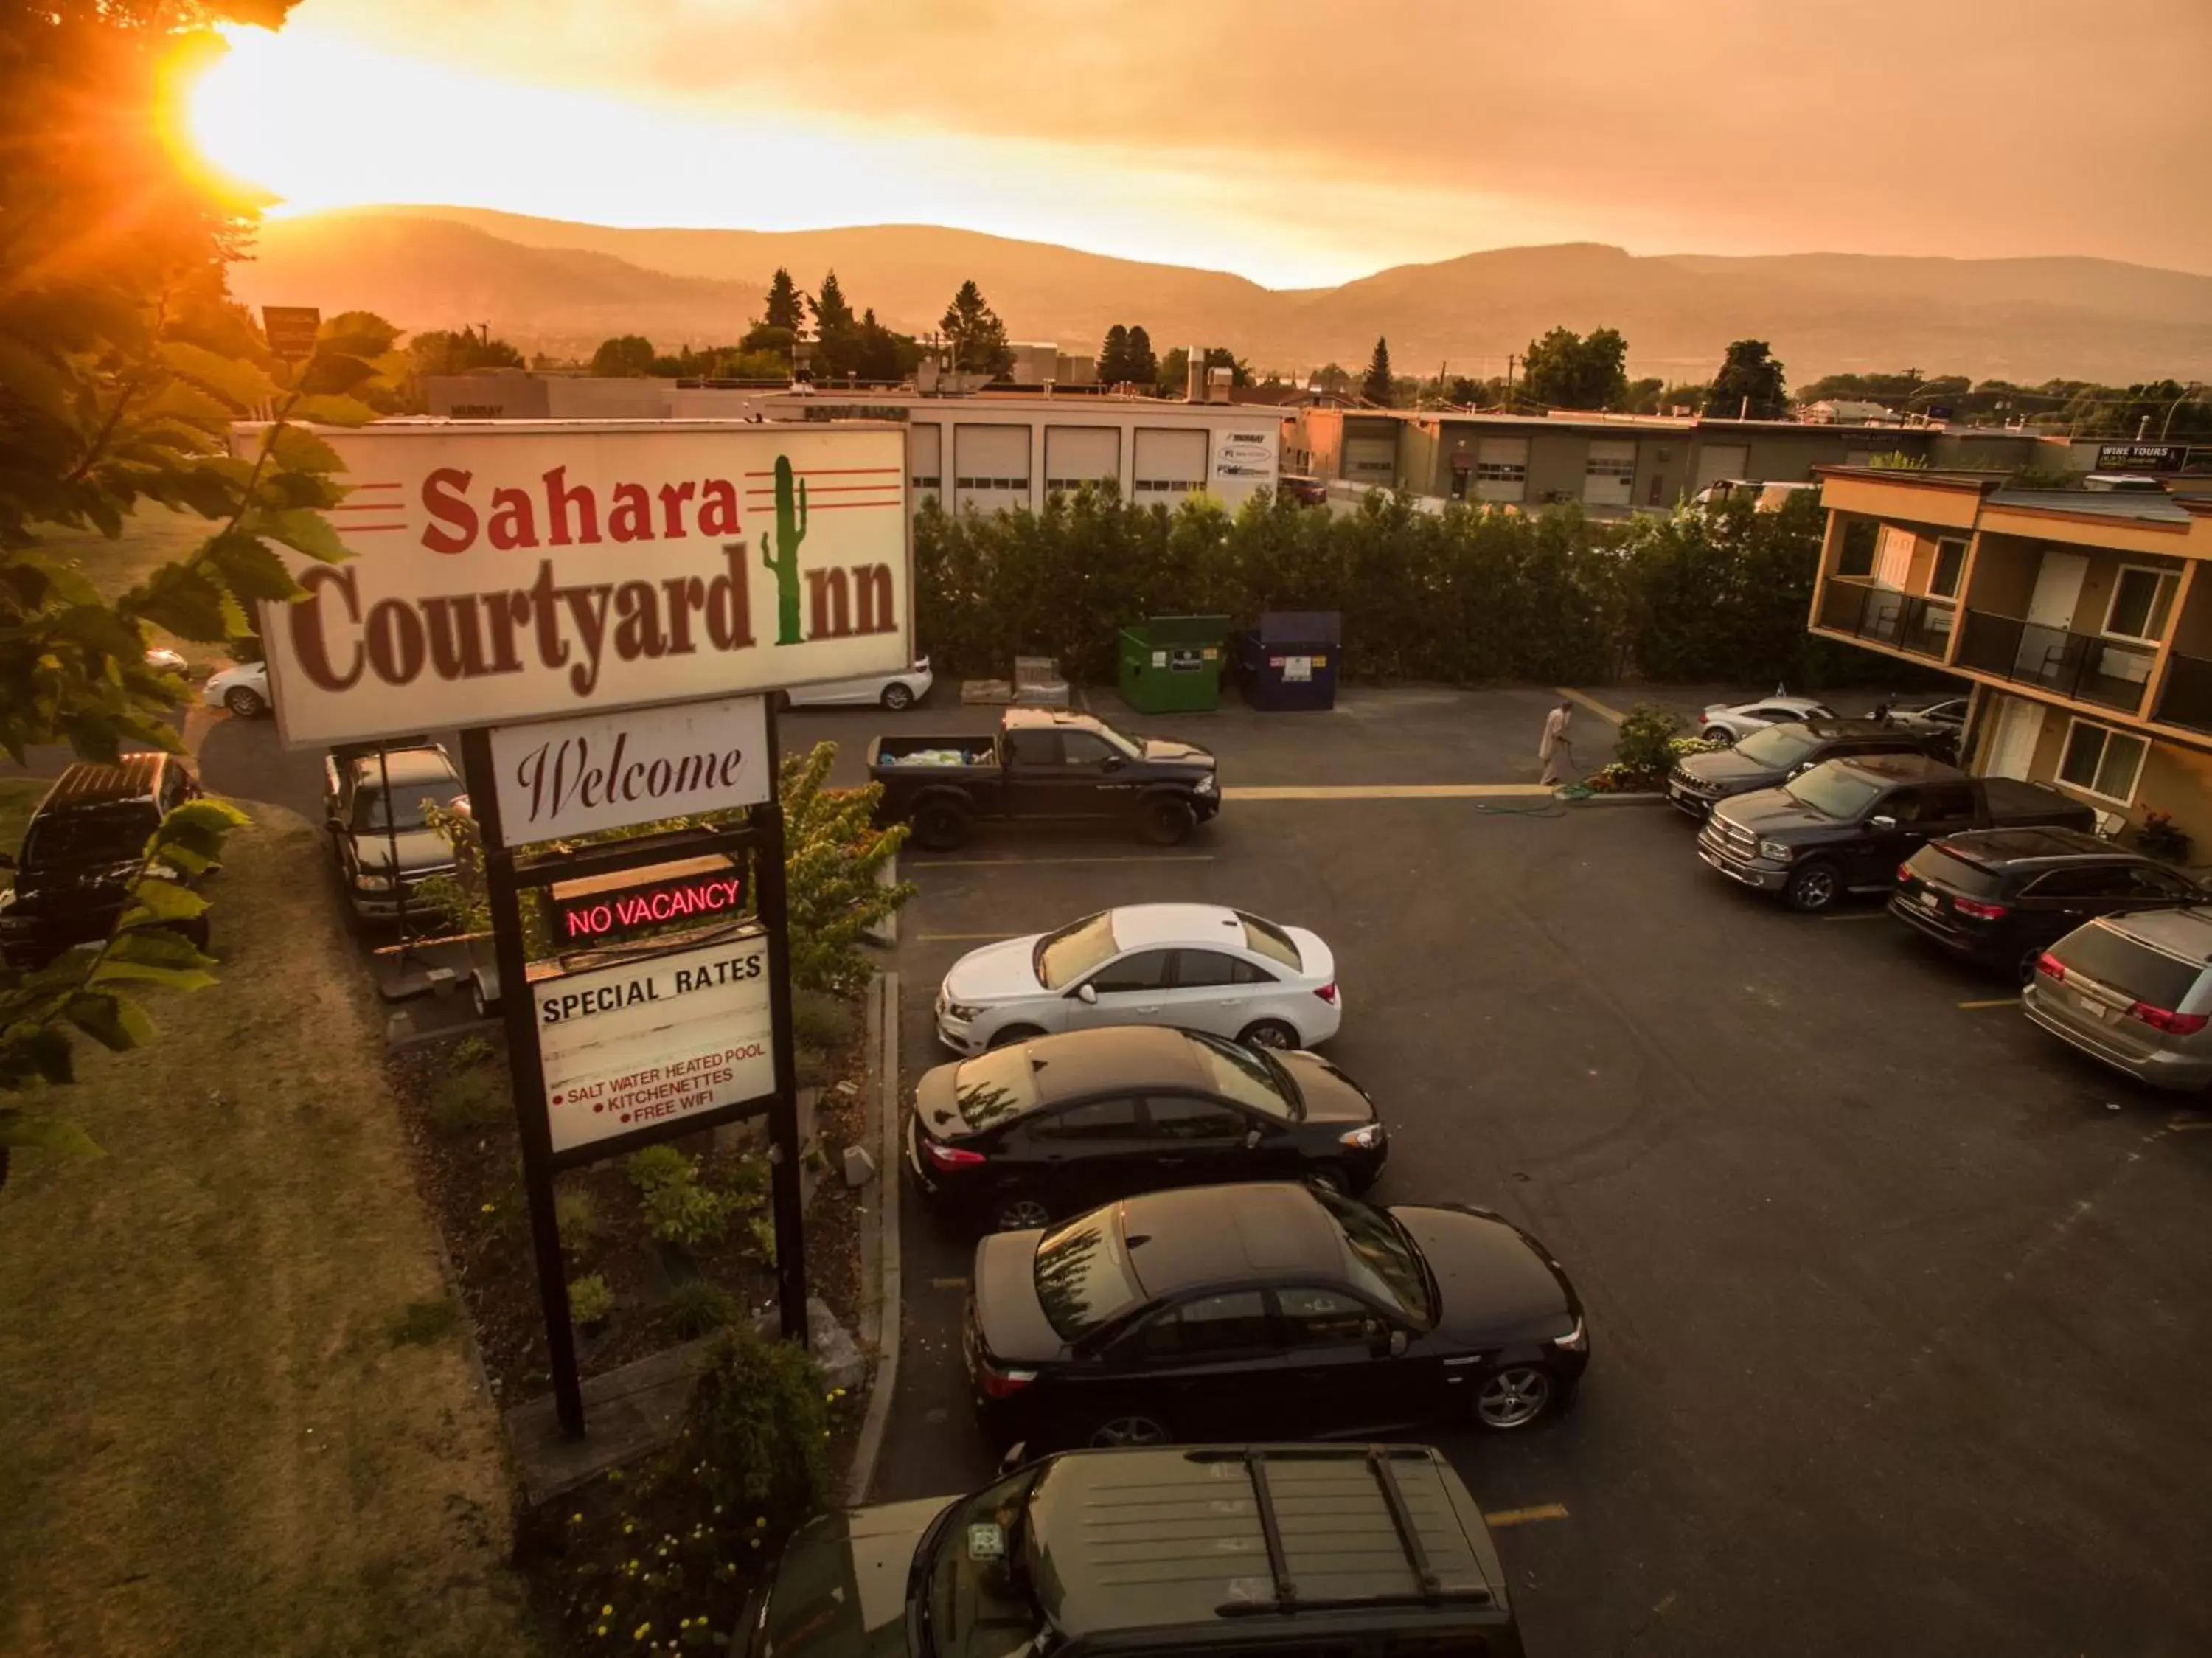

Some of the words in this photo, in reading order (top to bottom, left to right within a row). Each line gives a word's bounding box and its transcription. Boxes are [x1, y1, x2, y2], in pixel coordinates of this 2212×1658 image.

[2102, 447, 2129, 455] WINE
[2133, 447, 2168, 457] TOURS
[421, 465, 742, 555] Sahara
[289, 541, 757, 697] Courtyard
[517, 732, 742, 824] Welcome
[567, 906, 612, 937] NO
[616, 878, 740, 926] VACANCY
[542, 977, 659, 1024] SPECIAL
[675, 954, 761, 994] RATES
[567, 1081, 606, 1103] SALT
[609, 1069, 660, 1093] WATER
[666, 1053, 723, 1079] HEATED
[725, 1043, 766, 1064] POOL
[608, 1067, 734, 1111] KITCHENETTES
[633, 1103, 678, 1123] FREE
[679, 1089, 714, 1111] WIFI
